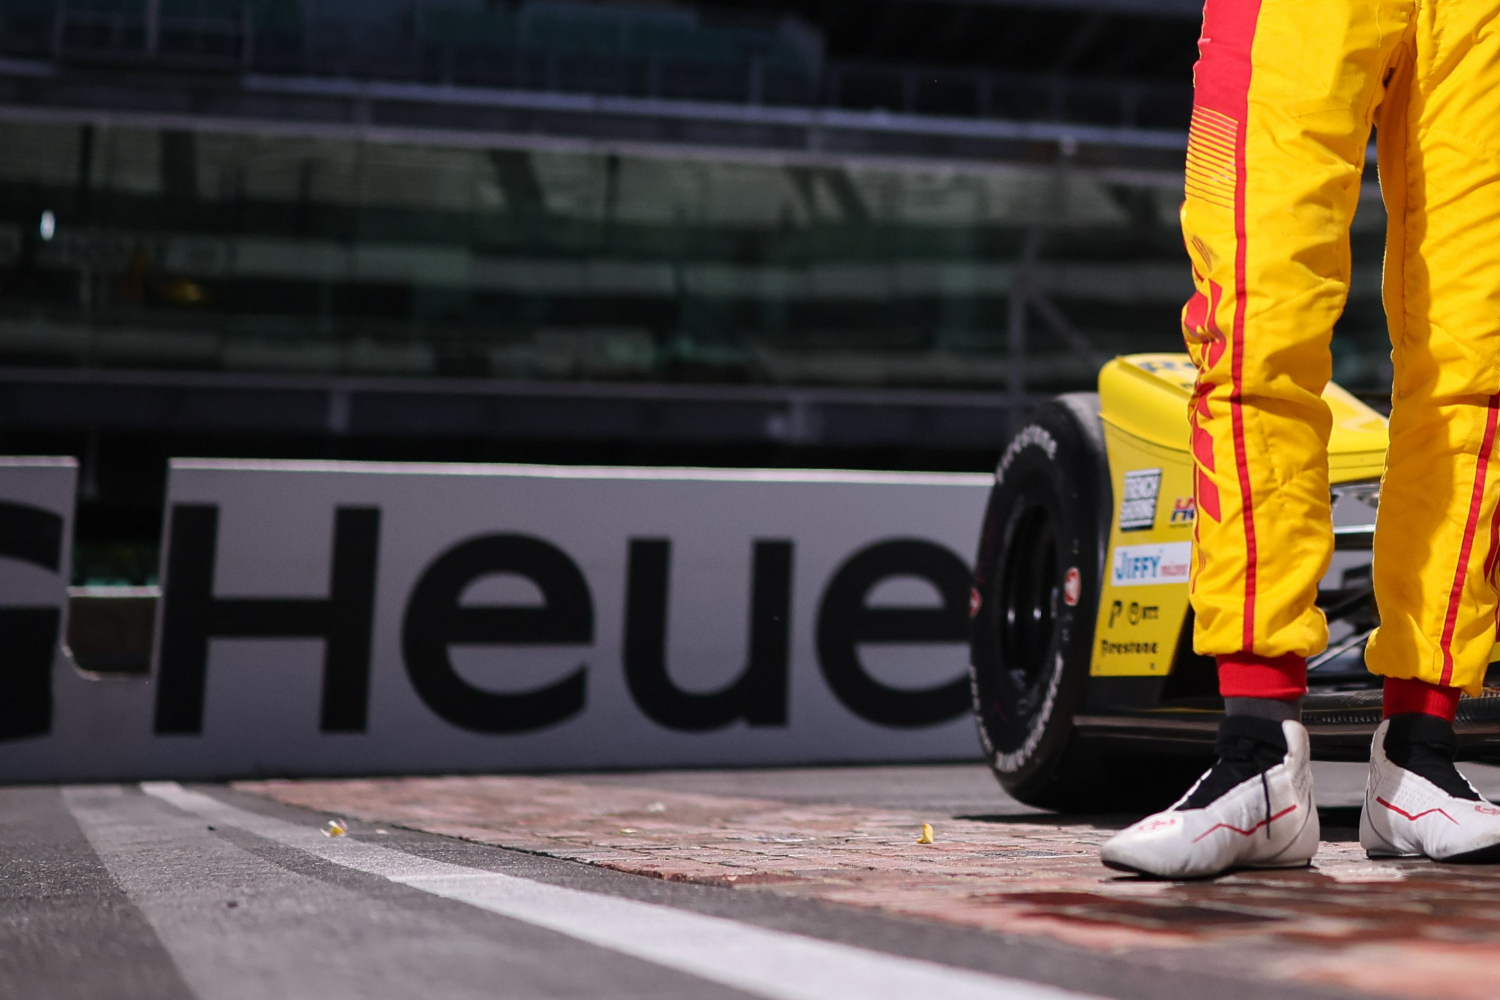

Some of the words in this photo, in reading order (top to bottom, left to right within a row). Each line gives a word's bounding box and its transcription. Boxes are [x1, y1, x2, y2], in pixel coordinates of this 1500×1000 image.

[1116, 551, 1161, 581] JIFFY
[153, 503, 976, 737] Heue
[1101, 639, 1158, 657] Firestone
